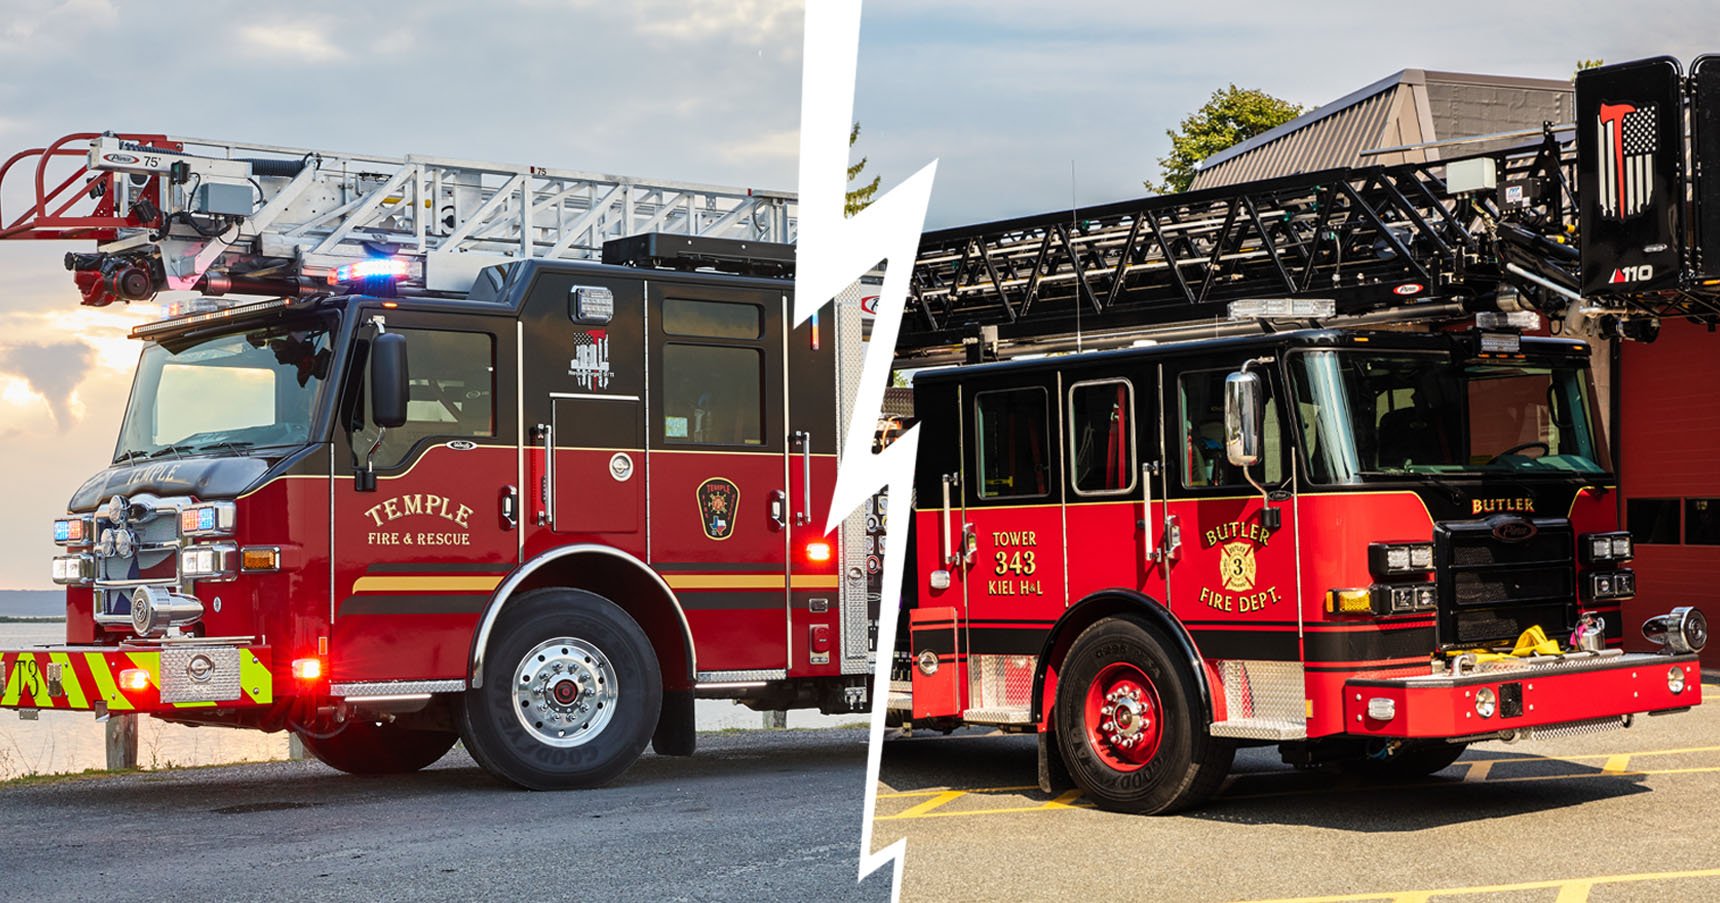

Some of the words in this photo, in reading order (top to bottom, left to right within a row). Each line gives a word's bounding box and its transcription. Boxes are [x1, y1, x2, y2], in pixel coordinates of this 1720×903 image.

[144, 156, 161, 167] 75'
[127, 462, 182, 486] TEMPLE
[364, 493, 474, 529] TEMPLE
[1471, 497, 1536, 515] BUTLER
[367, 532, 401, 545] FIRE
[403, 532, 413, 545] &
[417, 532, 470, 545] RESCUE
[992, 530, 1037, 547] TOWER
[1205, 521, 1270, 547] BUTLER
[995, 550, 1037, 576] 343
[1233, 558, 1243, 575] 3
[987, 580, 1016, 596] KIEL
[1199, 586, 1233, 613] FIRE
[1238, 586, 1282, 613] DEPT.
[13, 659, 40, 698] T3
